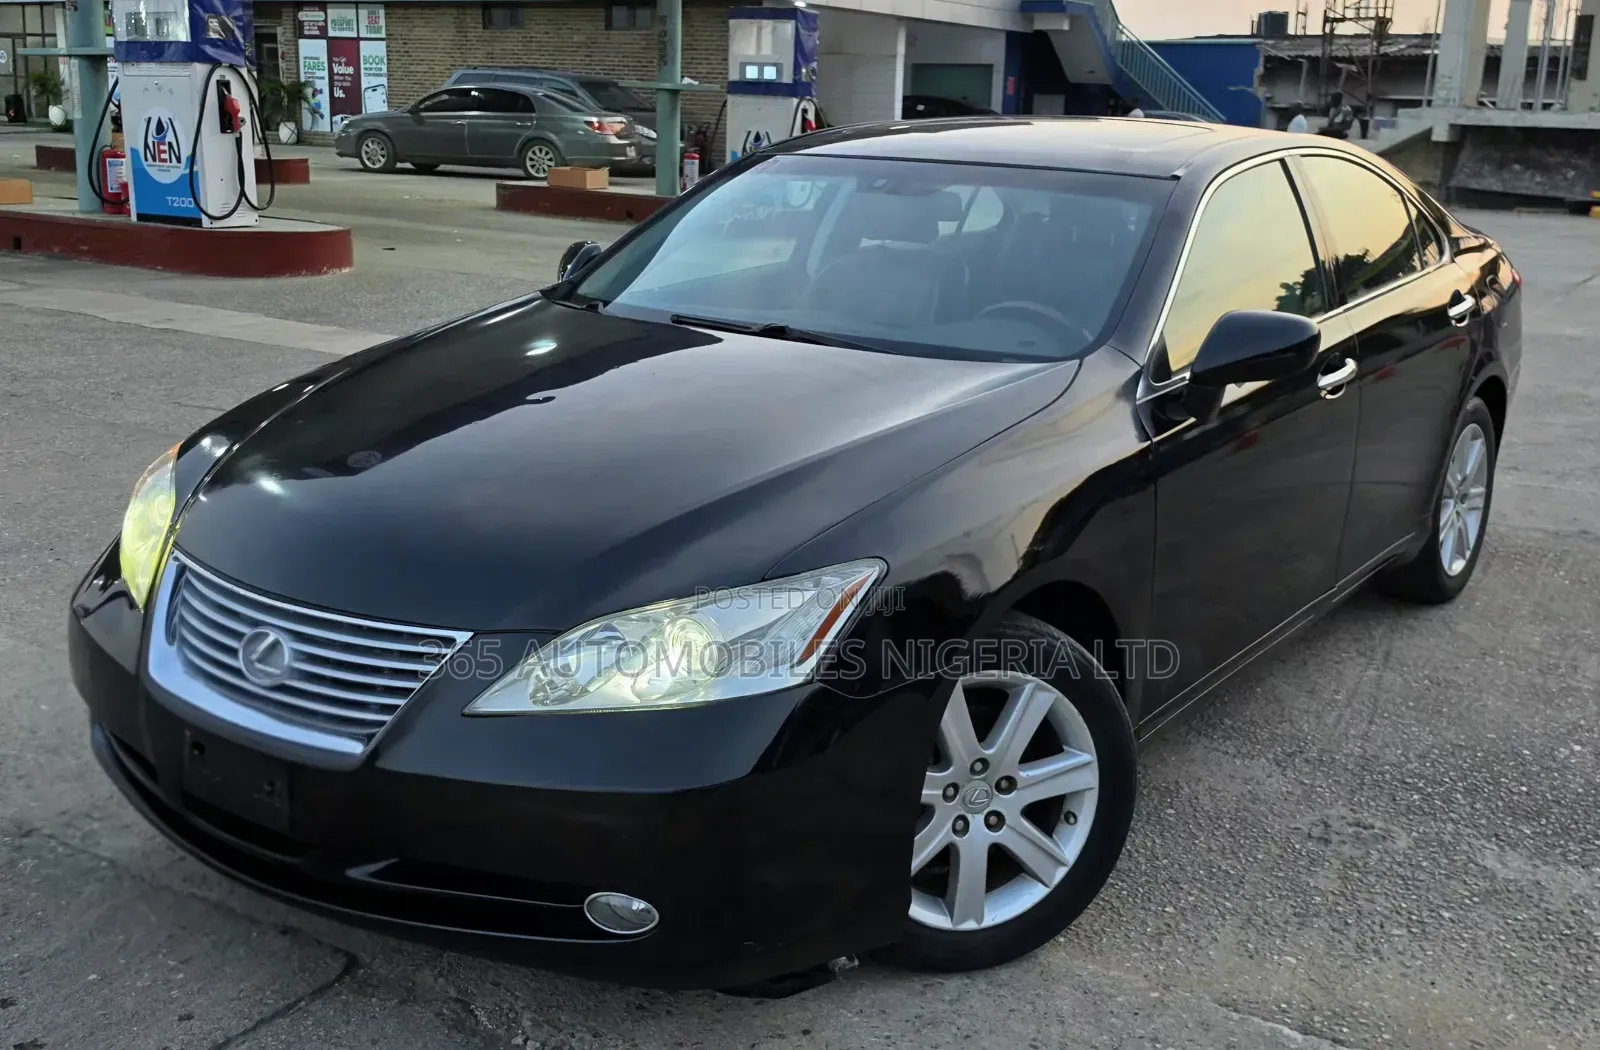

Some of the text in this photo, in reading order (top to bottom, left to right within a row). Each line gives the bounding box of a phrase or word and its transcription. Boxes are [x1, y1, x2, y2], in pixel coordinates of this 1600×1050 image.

[365, 25, 383, 34] TODAY
[363, 55, 386, 65] BOOK
[303, 61, 326, 71] FARES
[332, 63, 355, 74] Value
[334, 87, 346, 97] Us.
[165, 196, 195, 208] T200
